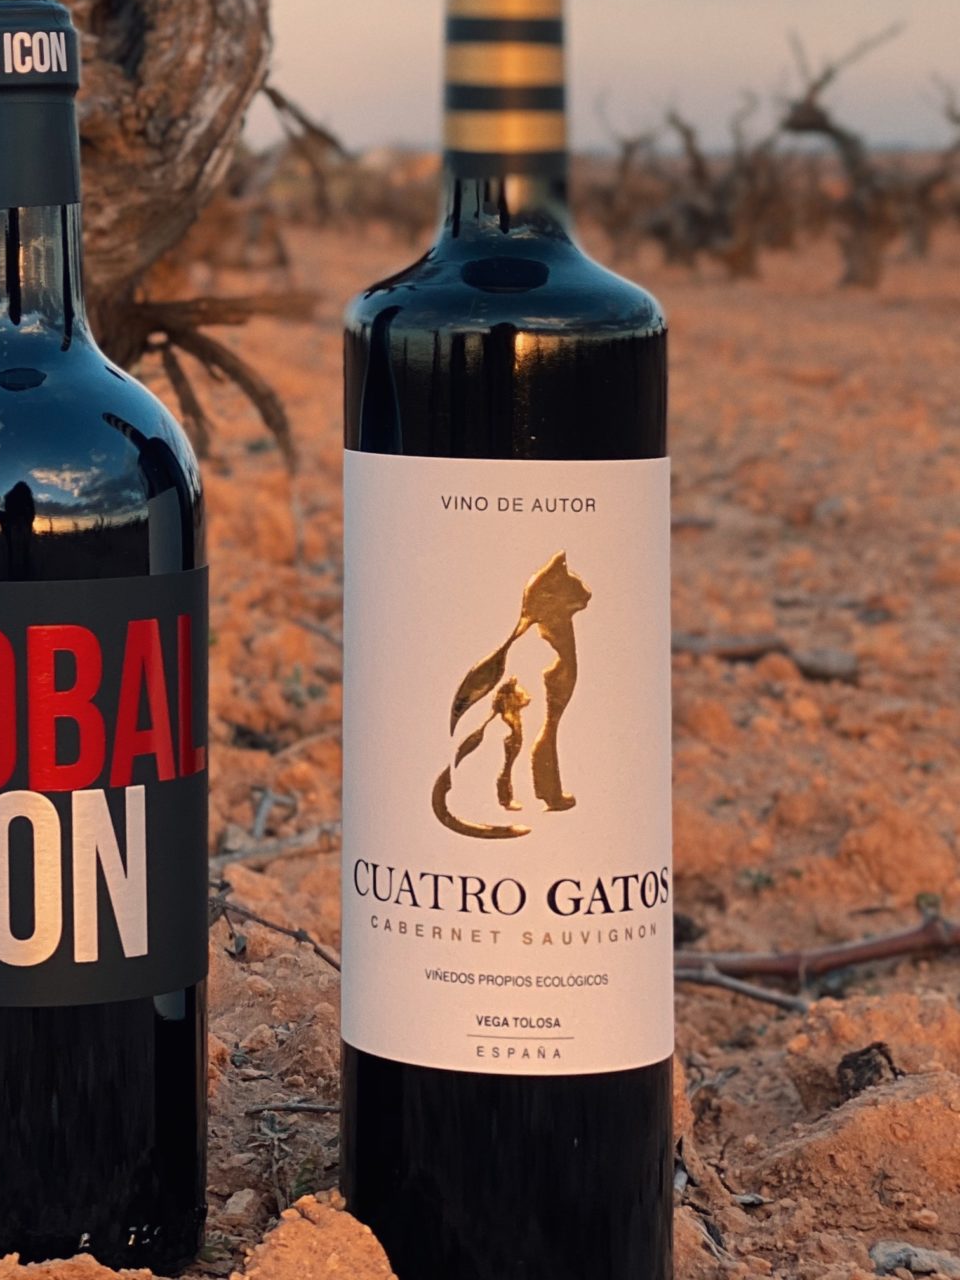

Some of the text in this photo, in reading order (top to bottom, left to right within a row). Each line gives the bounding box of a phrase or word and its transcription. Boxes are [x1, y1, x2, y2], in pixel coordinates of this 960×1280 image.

[3, 31, 67, 74] ICON
[441, 495, 596, 512] VINO DE AUTOR
[353, 858, 668, 916] CUATRO GATOS
[370, 915, 657, 946] CABERNET SAUVIGNON
[425, 967, 475, 985] VIÑEDOS
[478, 974, 532, 987] PROPIOS
[476, 1015, 561, 1029] VEGA TOLOSA
[476, 1045, 561, 1059] ESPAÑA
